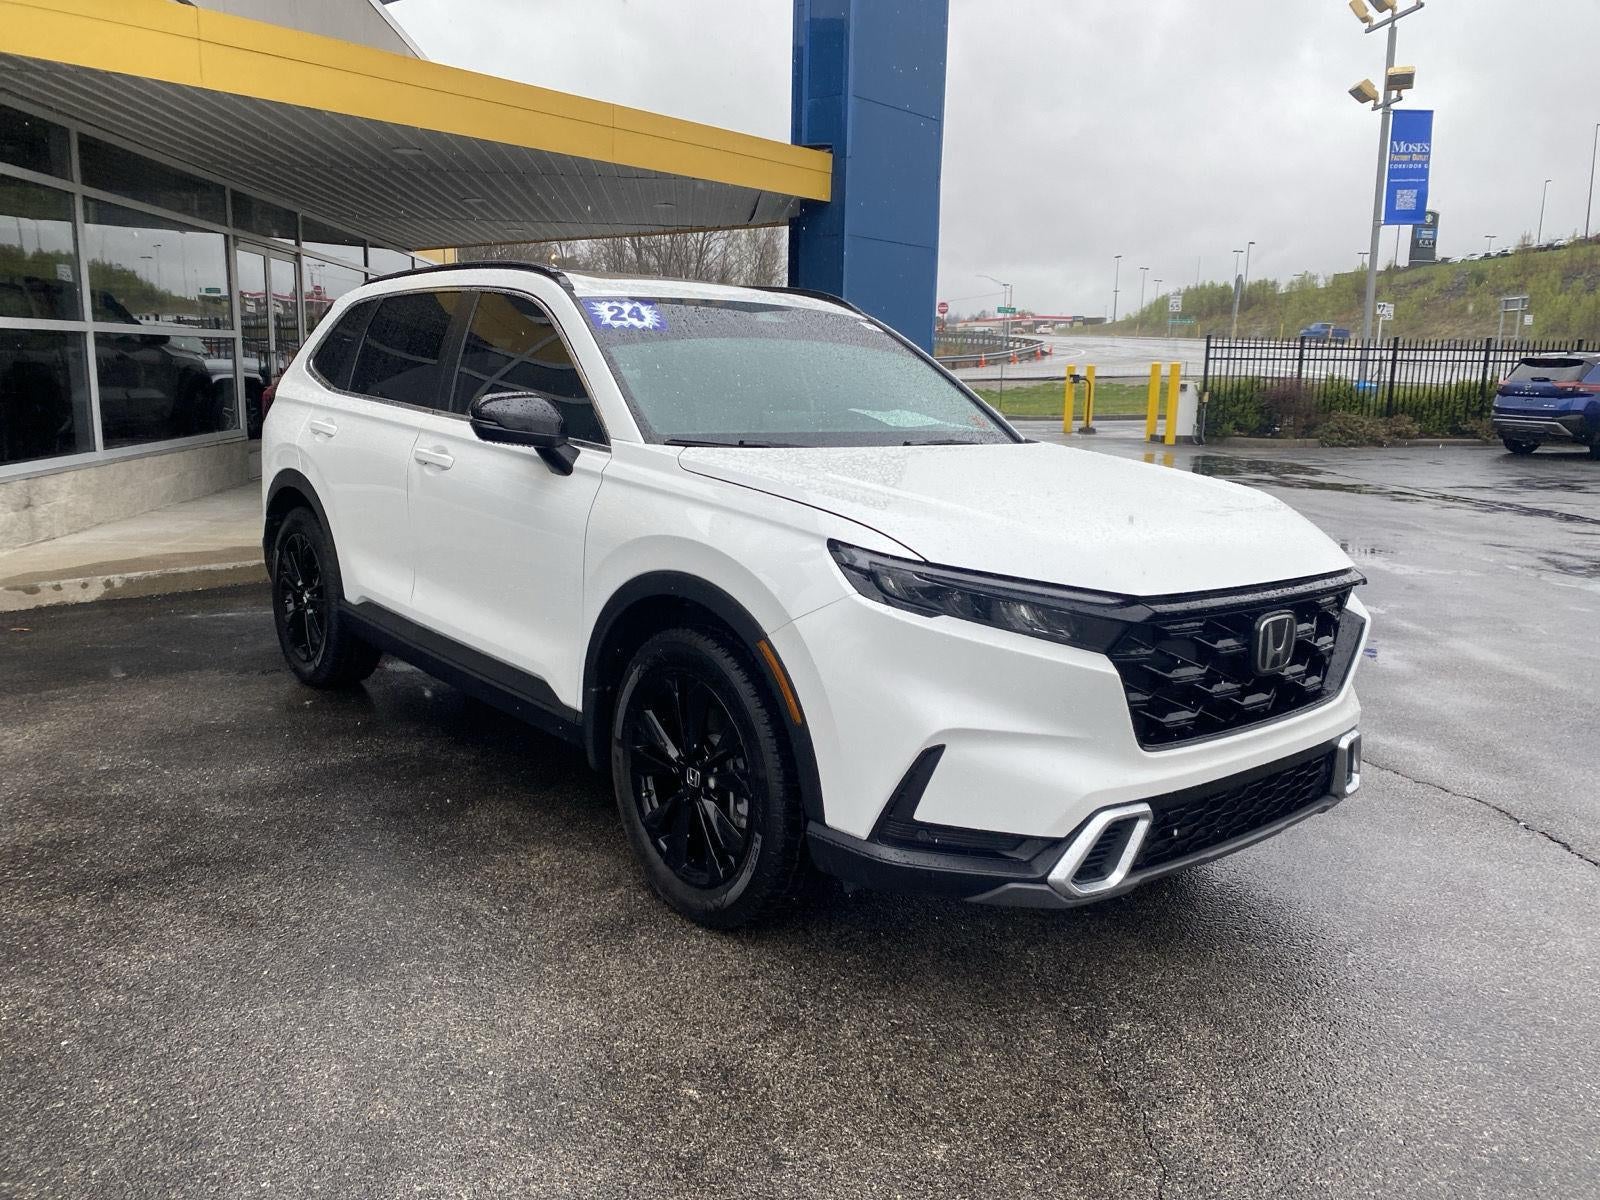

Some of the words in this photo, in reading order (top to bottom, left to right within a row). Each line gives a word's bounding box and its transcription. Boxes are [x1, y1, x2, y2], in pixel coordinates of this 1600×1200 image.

[1392, 141, 1430, 153] MOSES
[1170, 303, 1180, 311] 55
[607, 305, 645, 322] 24
